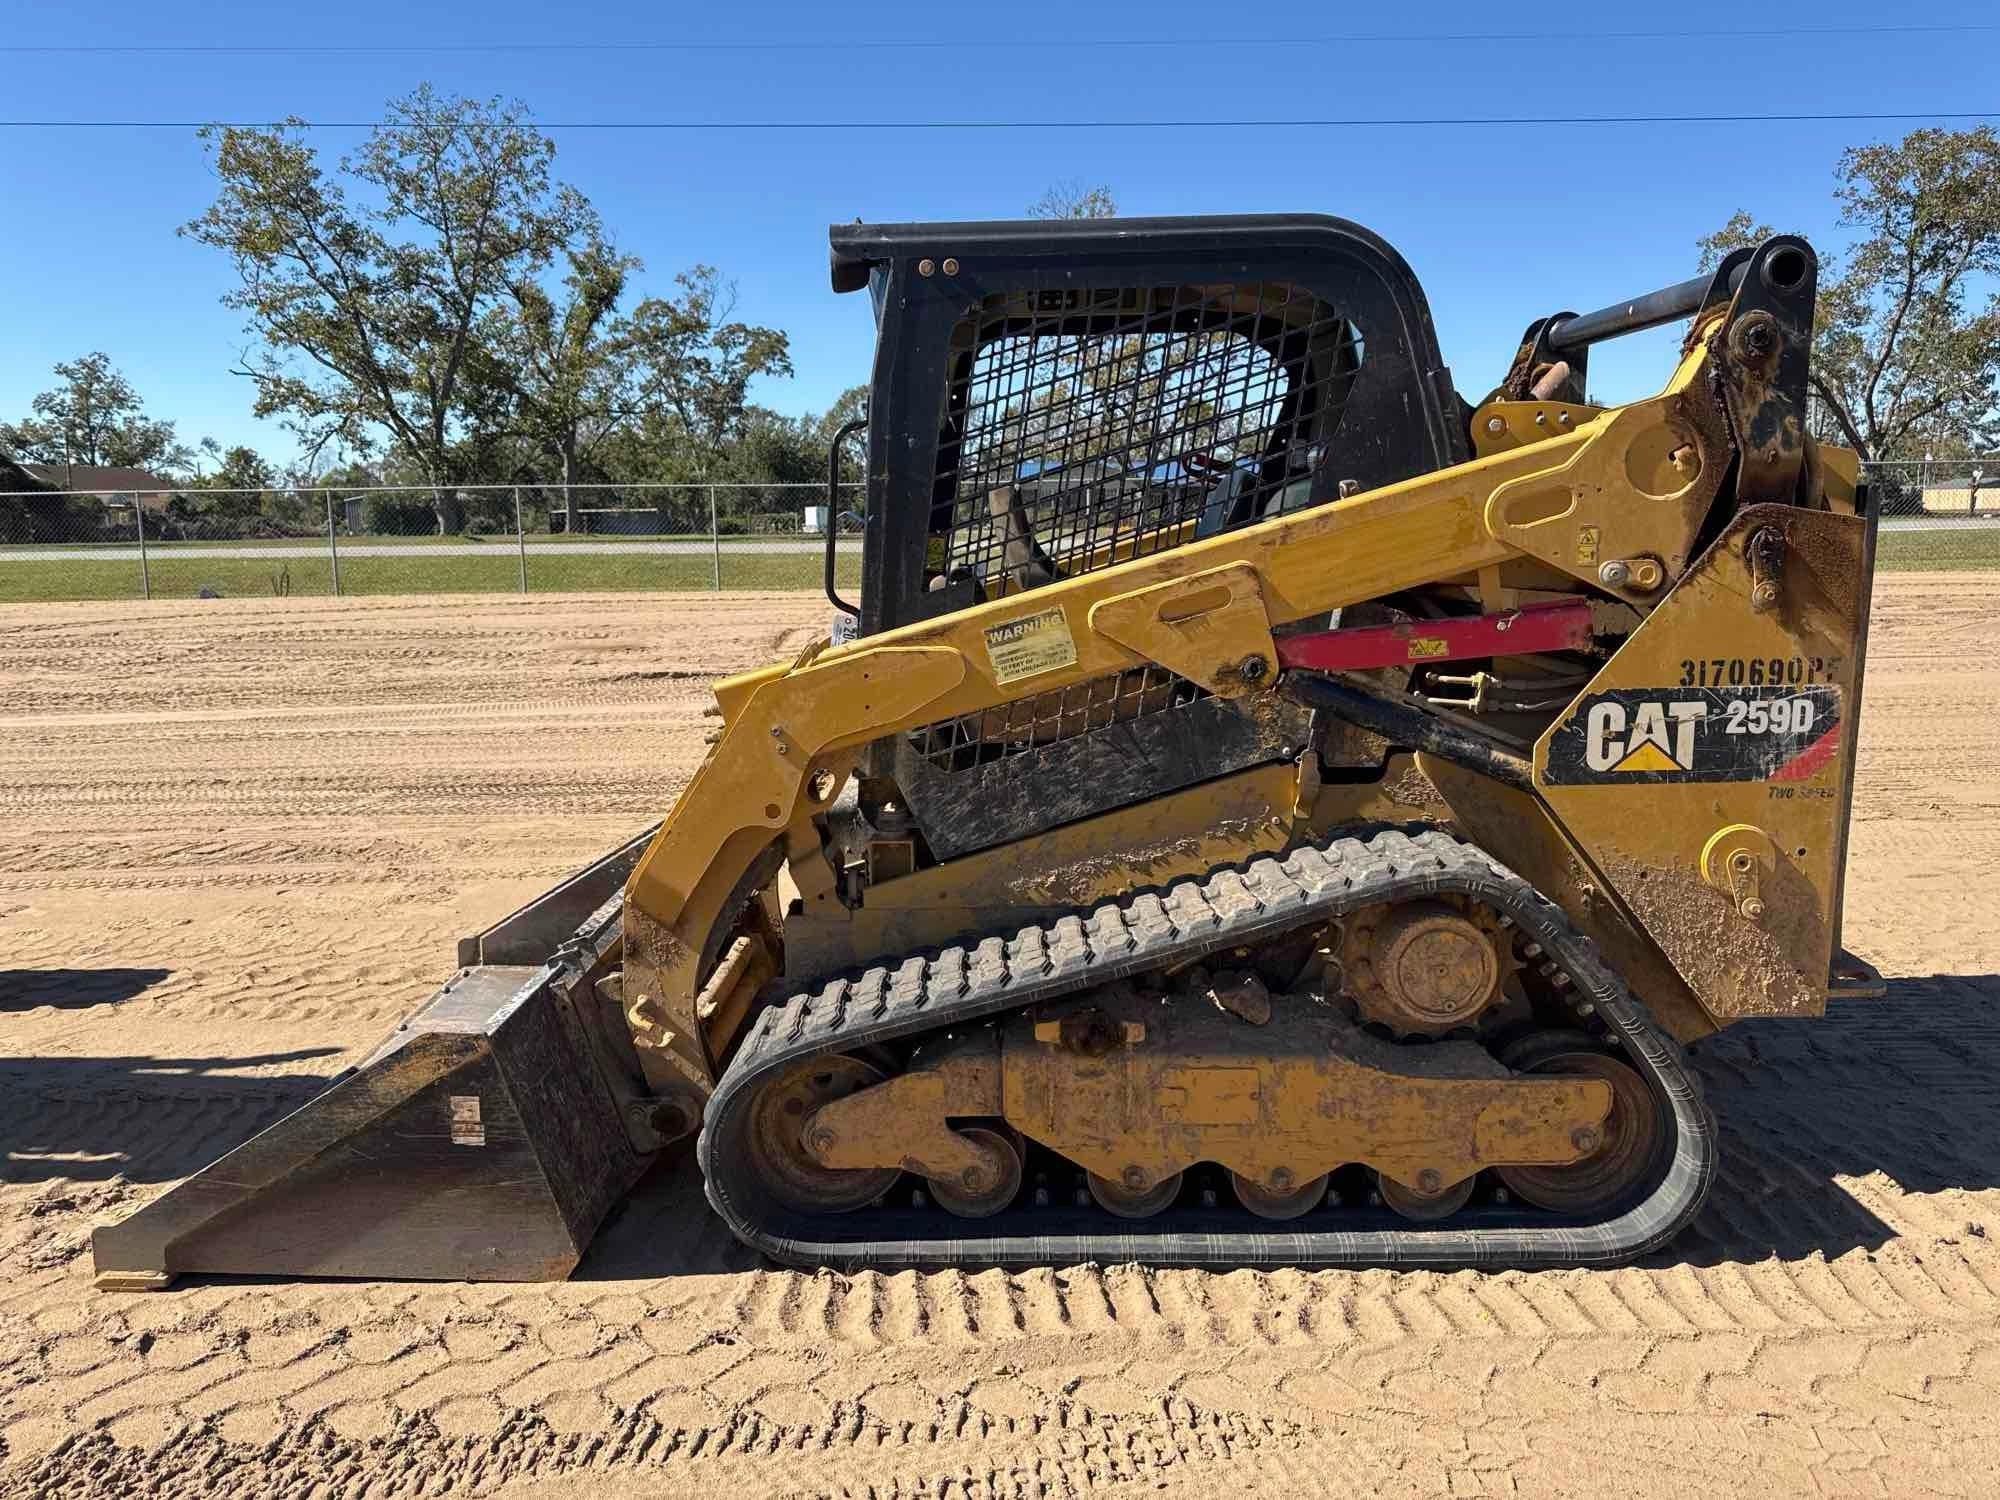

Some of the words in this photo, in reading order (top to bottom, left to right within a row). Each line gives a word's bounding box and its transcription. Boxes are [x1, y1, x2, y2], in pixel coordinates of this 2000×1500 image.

[990, 613, 1063, 644] WARNING
[1586, 701, 1707, 771] CAT
[1725, 699, 1814, 734] 259D
[1768, 786, 1794, 799] TWO
